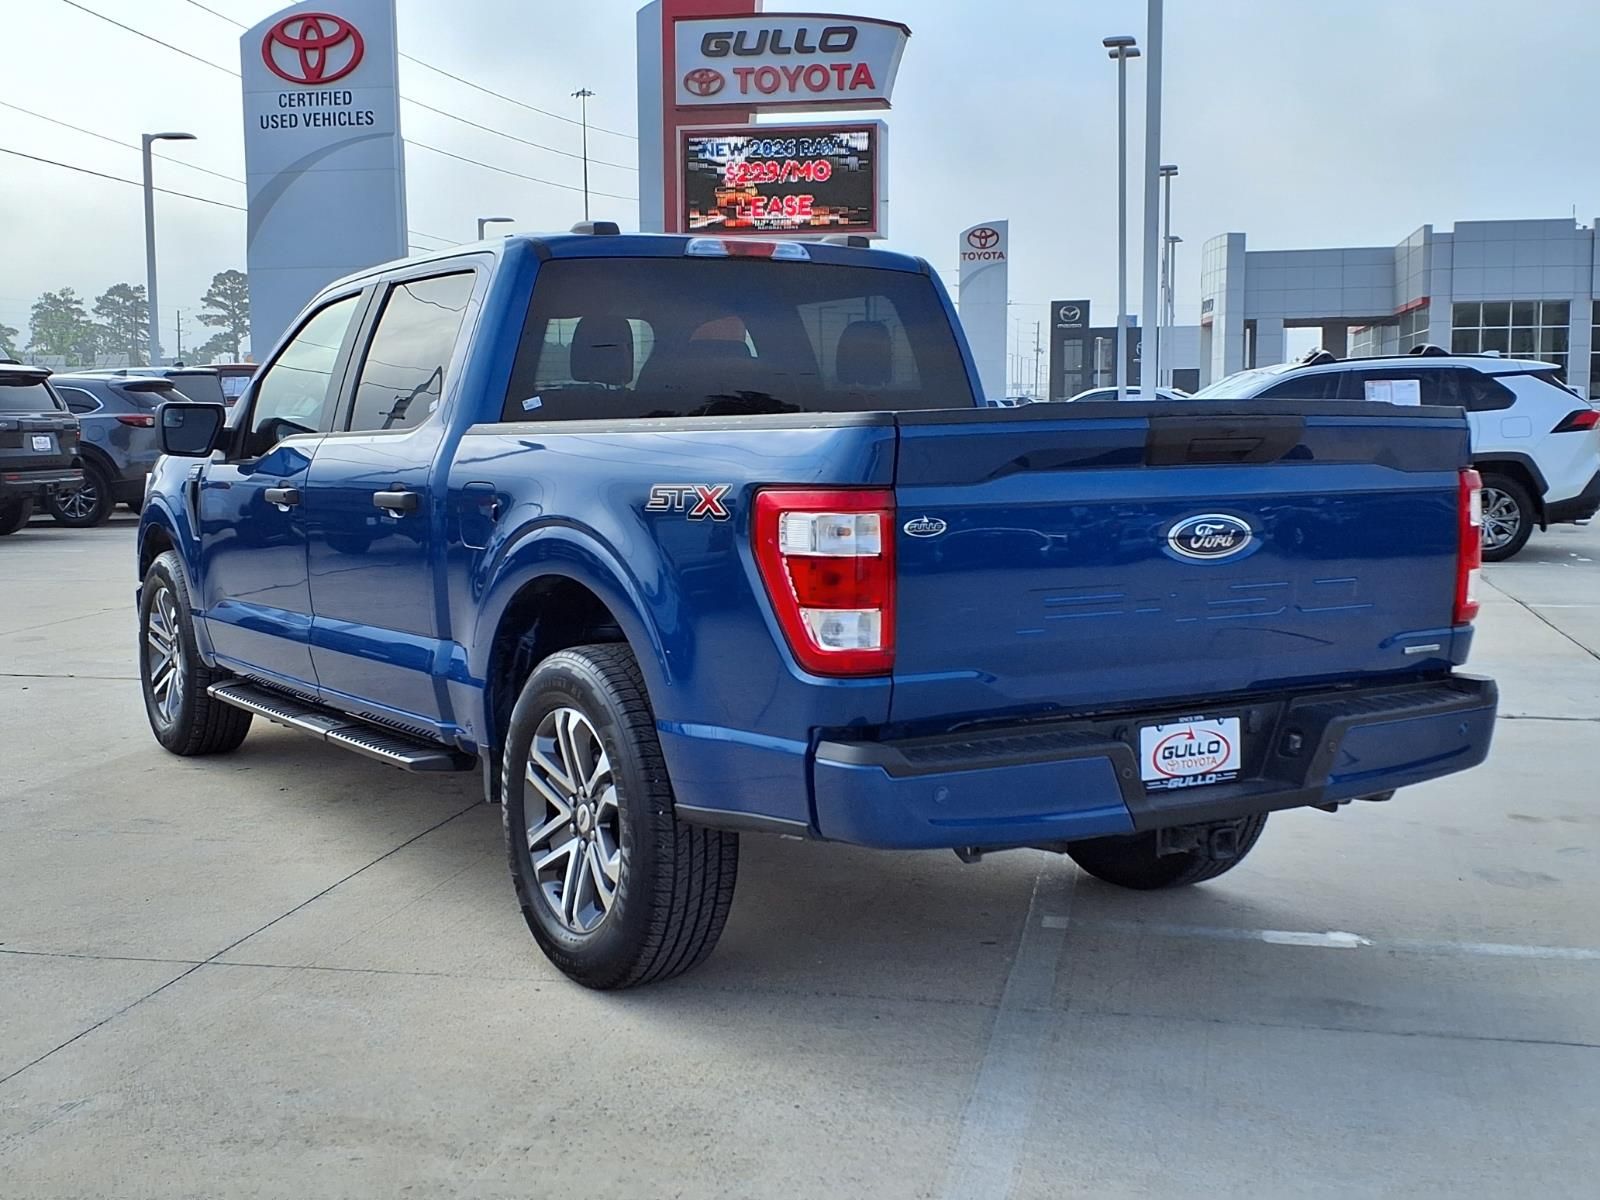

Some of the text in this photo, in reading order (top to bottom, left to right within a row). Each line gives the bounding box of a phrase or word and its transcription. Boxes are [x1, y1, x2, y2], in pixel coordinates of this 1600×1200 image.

[701, 26, 858, 58] GULLO
[733, 63, 876, 94] TOYOTA
[278, 90, 353, 108] CERTIFIED
[260, 110, 374, 129] USED VEHICLES
[699, 141, 745, 157] NEW
[736, 195, 815, 218] LEASE
[961, 251, 1005, 261] TOYOTA
[645, 483, 733, 521] STX
[1190, 523, 1235, 549] Ford
[1162, 740, 1221, 760] GULLO
[1182, 756, 1217, 769] TOYOTA
[1168, 773, 1217, 788] GULLO
